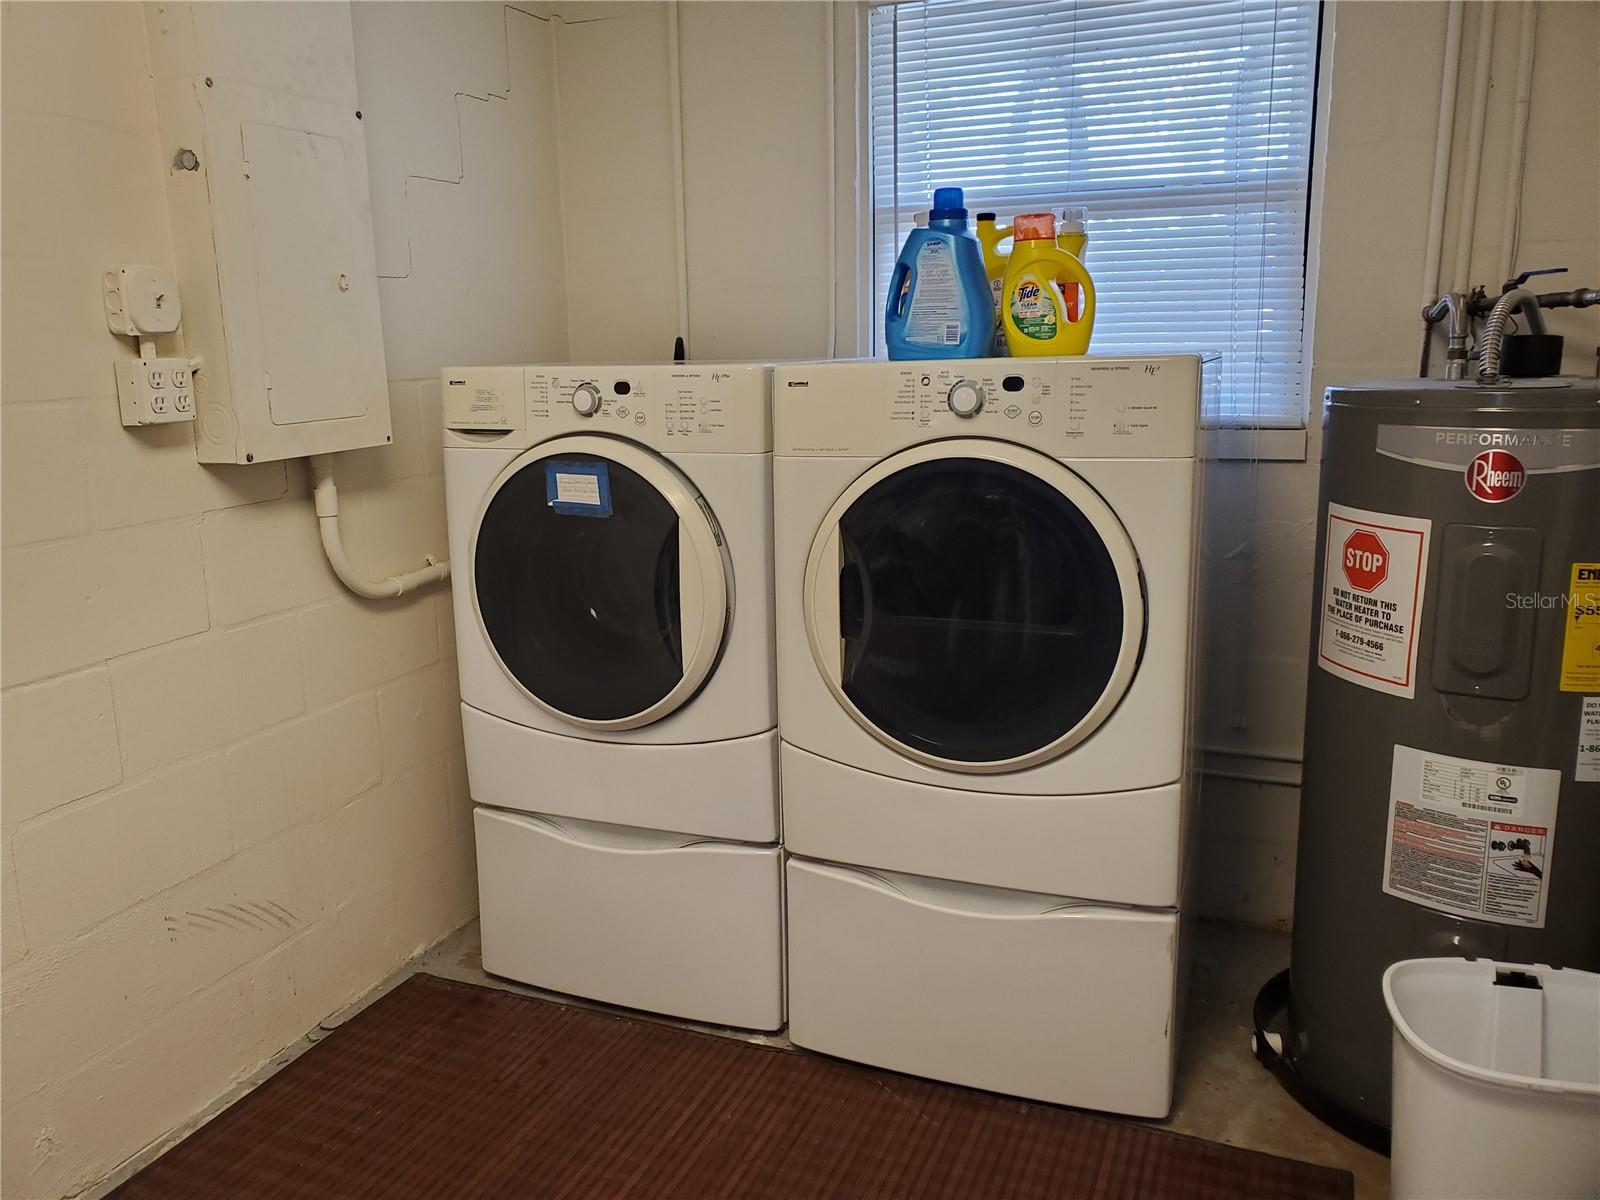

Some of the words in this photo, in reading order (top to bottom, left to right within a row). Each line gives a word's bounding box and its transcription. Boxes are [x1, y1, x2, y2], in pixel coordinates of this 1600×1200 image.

[1019, 285, 1040, 302] Tide
[1435, 432, 1572, 446] PERFORMANE
[1472, 452, 1522, 493] Rheem
[1346, 548, 1383, 573] STOP
[1333, 587, 1339, 596] DO
[1341, 590, 1351, 600] NOT
[1352, 594, 1378, 607] RETURN
[1380, 601, 1397, 611] THIS
[1335, 597, 1353, 611] WATER
[1354, 604, 1379, 618] HEATER
[1382, 611, 1391, 621] TO
[1336, 608, 1353, 621] PLACE
[1354, 614, 1363, 623] OF
[1365, 617, 1404, 633] PURCHASE
[1335, 629, 1384, 651] 1-866-279-4566
